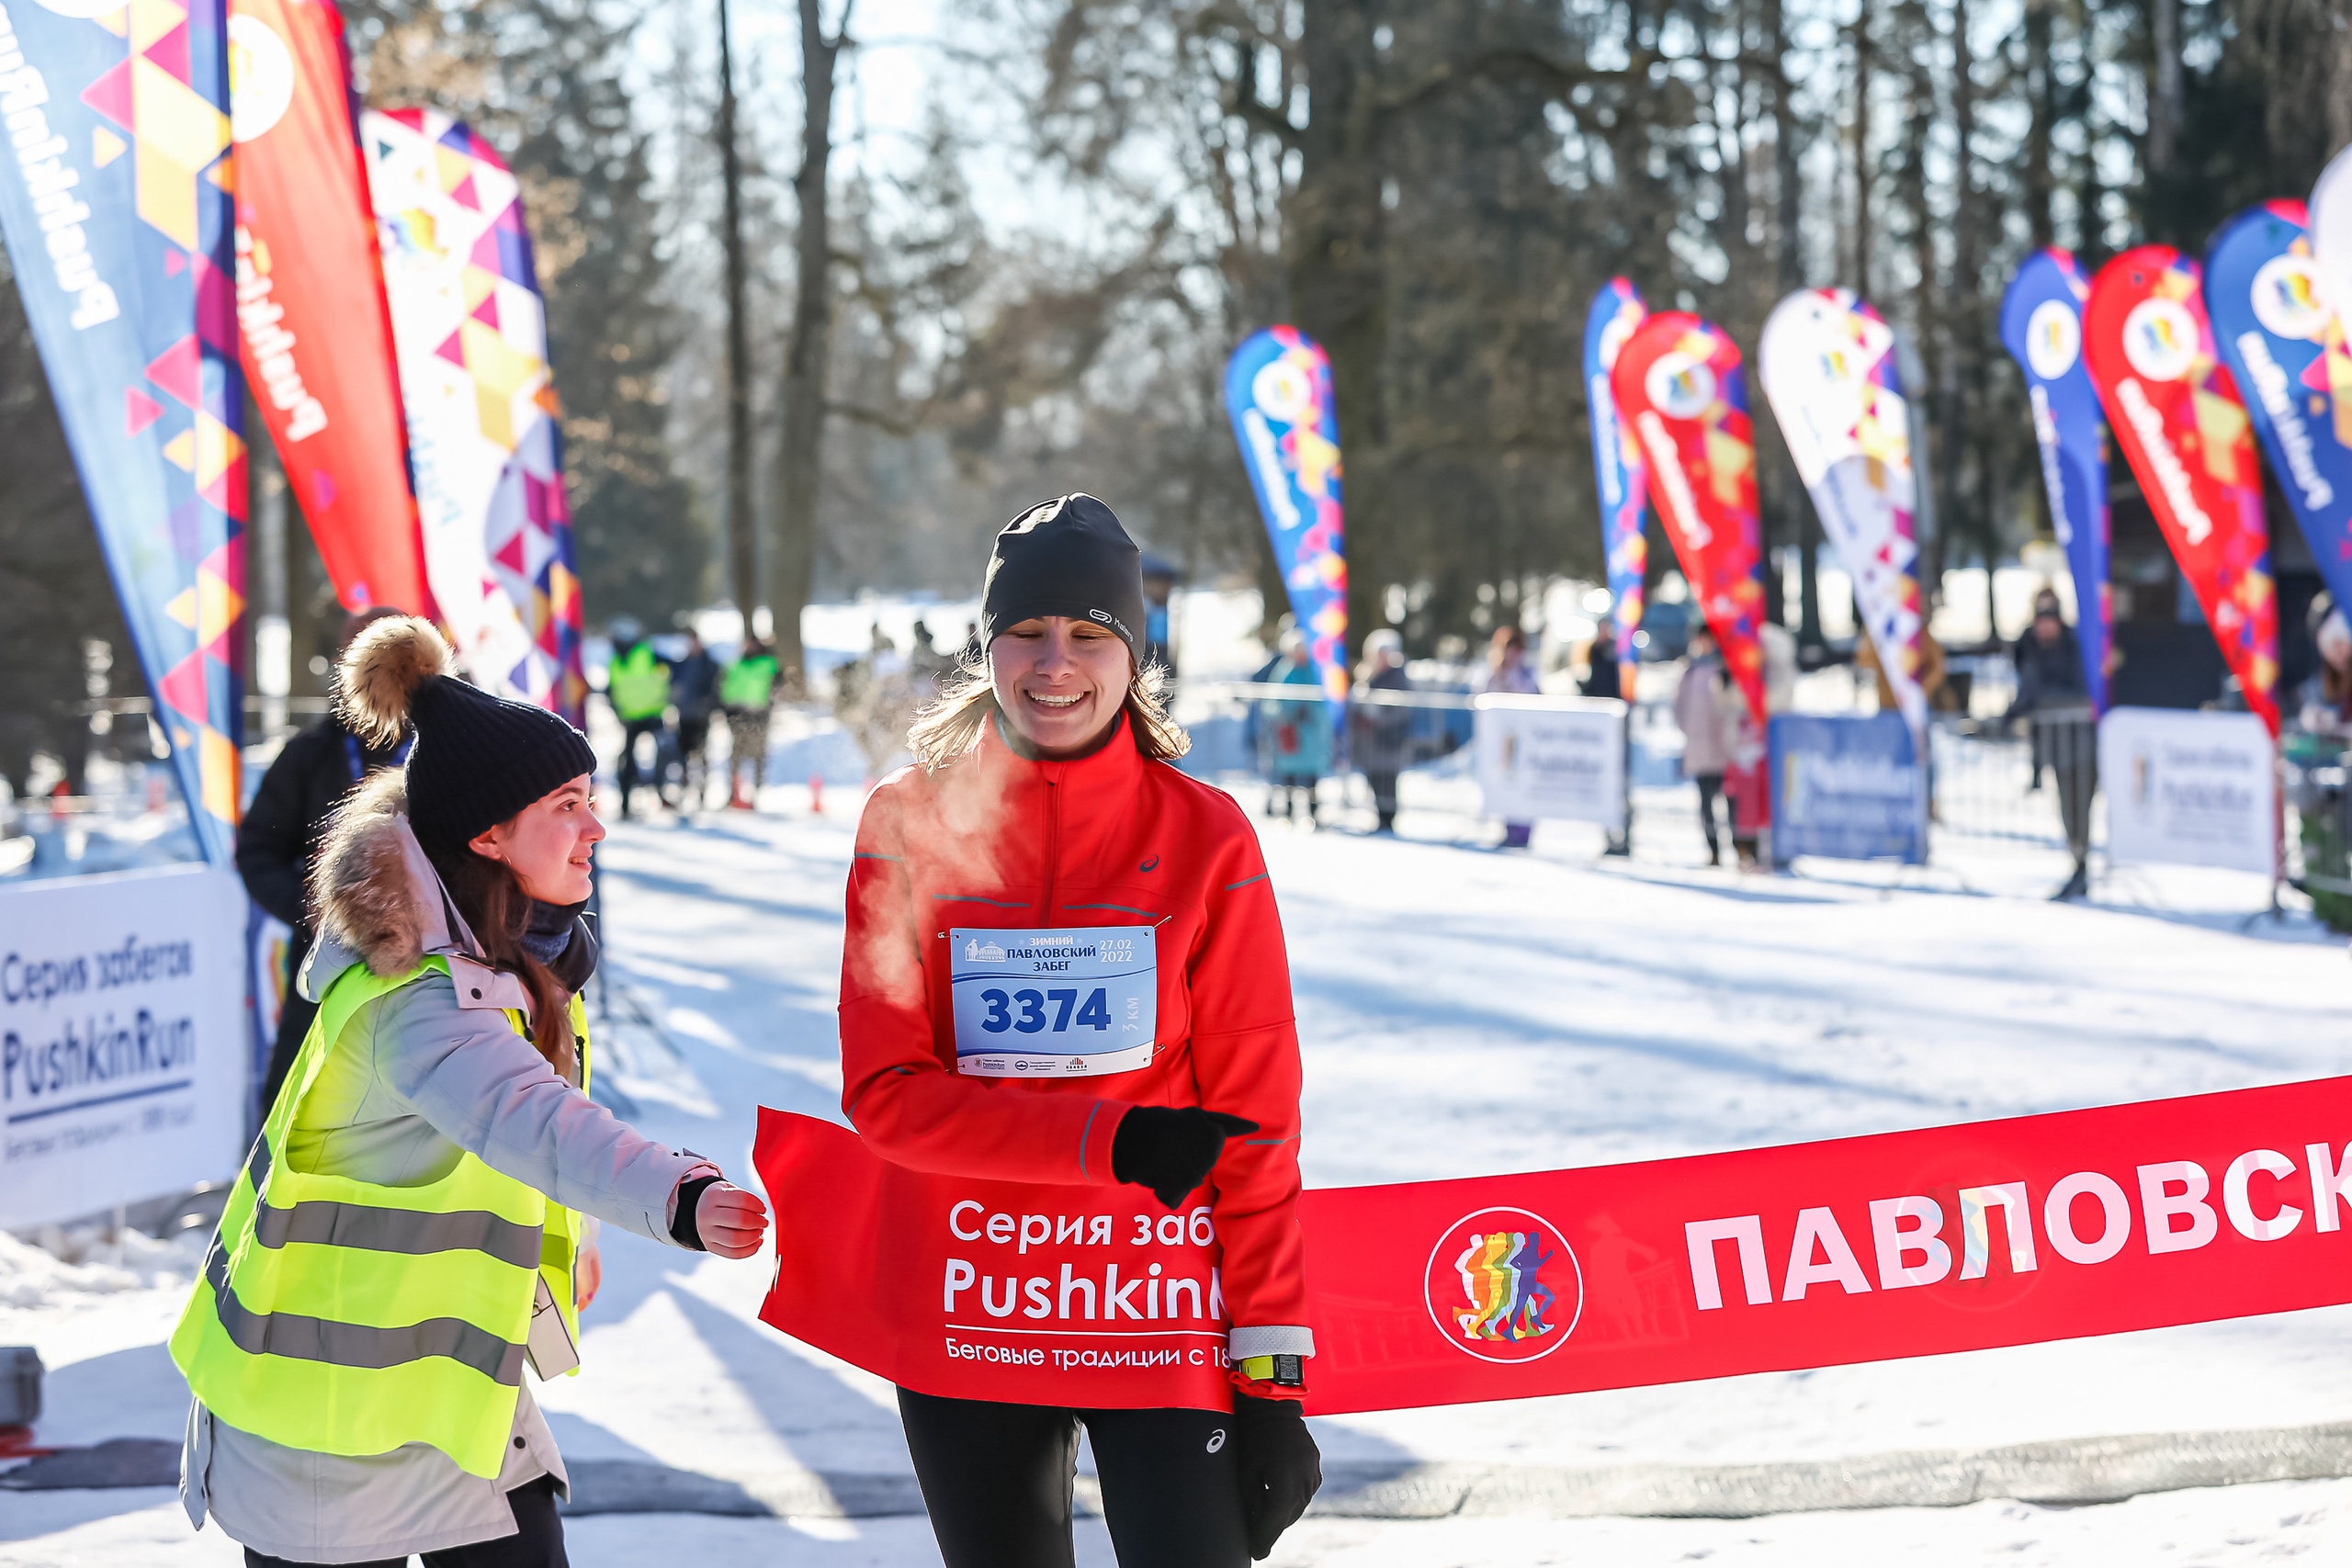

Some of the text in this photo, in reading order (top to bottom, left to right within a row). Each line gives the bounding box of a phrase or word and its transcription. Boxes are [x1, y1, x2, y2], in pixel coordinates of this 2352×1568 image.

[1029, 935, 1074, 946] ЗИМНИЙ
[1099, 939, 1136, 951] 27.02.
[1007, 944, 1096, 959] ПАВЛОВСКИЙ
[1100, 950, 1134, 964] 2022
[1033, 960, 1071, 972] ЗАБЕГ
[979, 987, 1112, 1033] 3374
[1122, 1022, 1139, 1036] 3
[3, 1009, 196, 1103] PushkinRun
[948, 1200, 1113, 1255] Серия
[1683, 1140, 2352, 1311] ПАВЛОВСК
[944, 1337, 1231, 1371] Беговые традиции с 18
